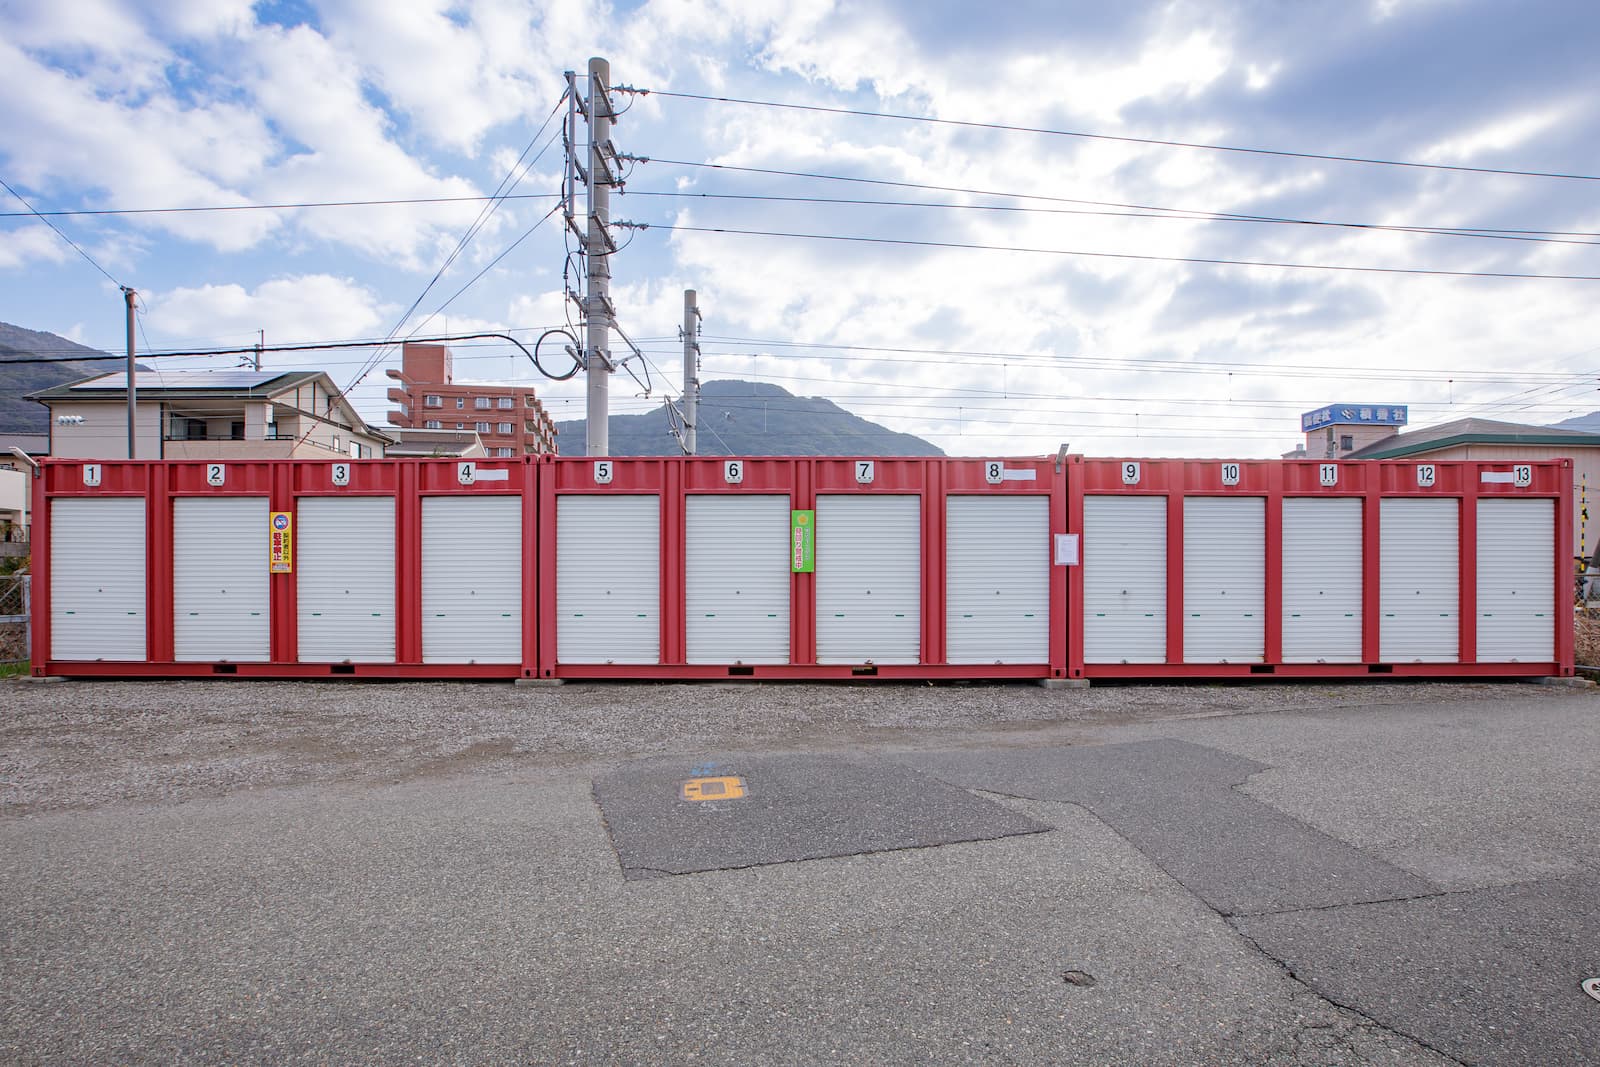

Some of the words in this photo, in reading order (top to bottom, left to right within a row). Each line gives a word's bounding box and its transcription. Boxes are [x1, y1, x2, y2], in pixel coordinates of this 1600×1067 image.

[88, 466, 94, 480] 1
[211, 466, 221, 480] 2
[335, 466, 345, 480] 3
[461, 464, 472, 478] 4
[598, 463, 608, 477] 5
[728, 463, 738, 477] 6
[859, 463, 869, 477] 7
[989, 463, 999, 478] 8
[1126, 464, 1136, 478] 9
[1223, 465, 1237, 479] 10
[1322, 466, 1335, 480] 11
[1419, 466, 1433, 481] 12
[1516, 466, 1530, 481] 13
